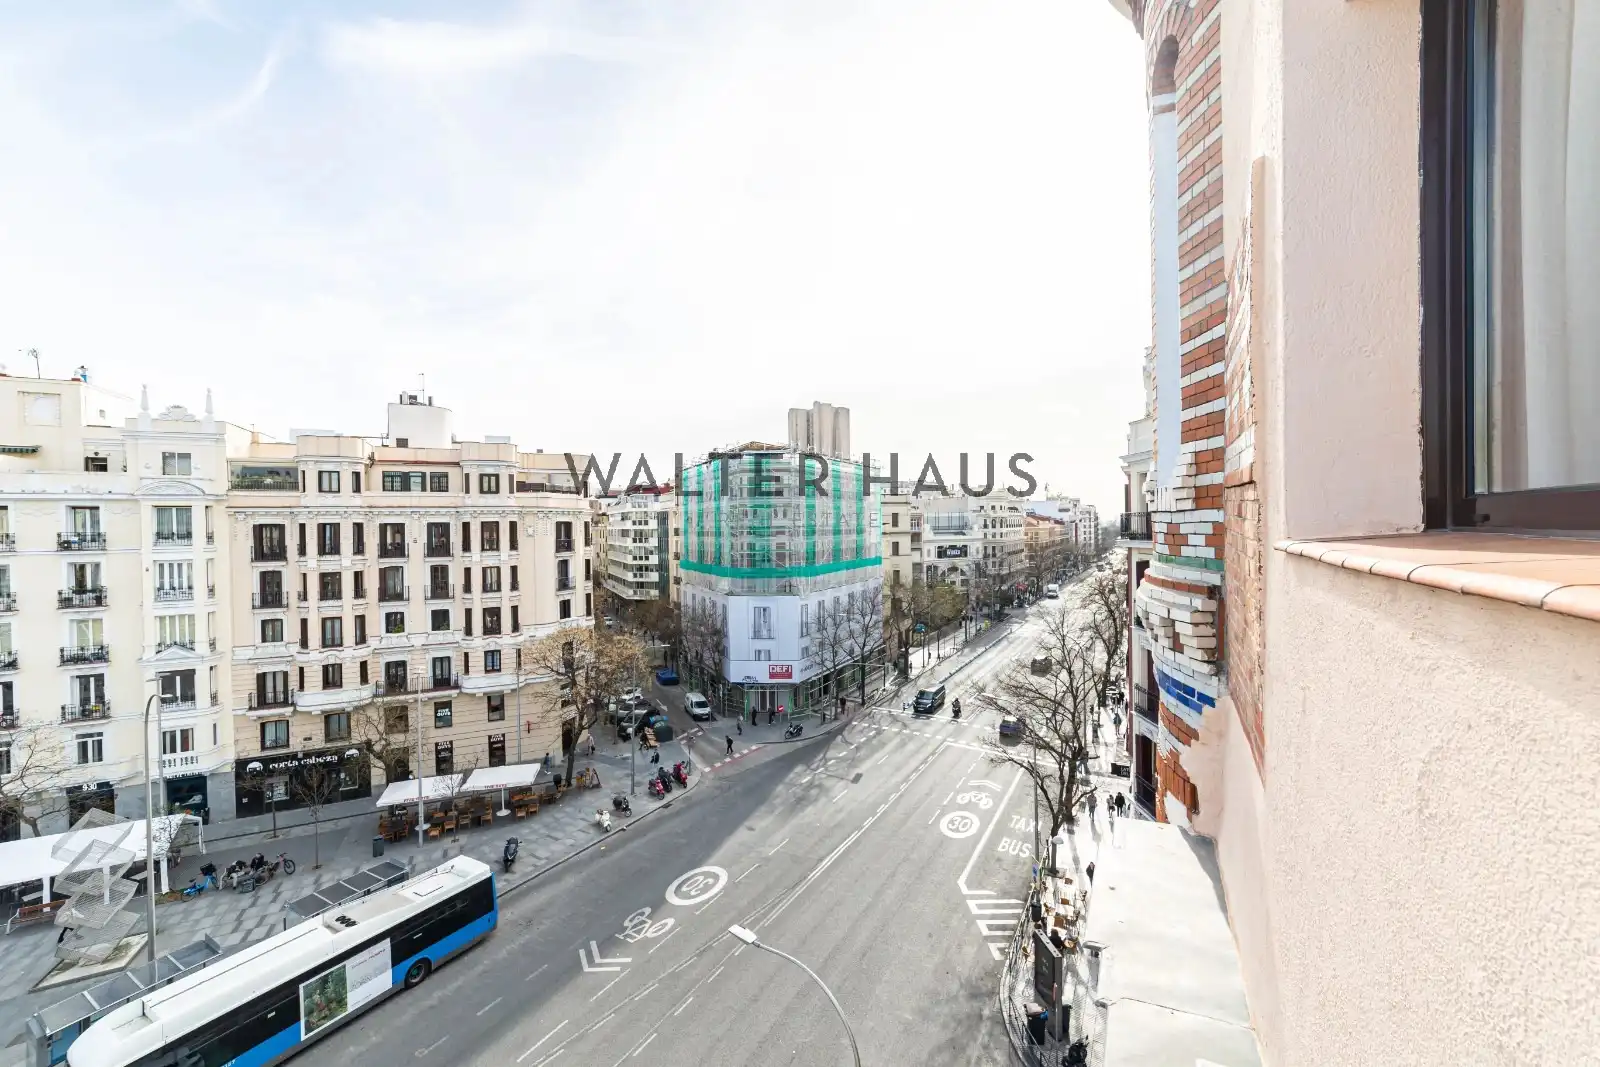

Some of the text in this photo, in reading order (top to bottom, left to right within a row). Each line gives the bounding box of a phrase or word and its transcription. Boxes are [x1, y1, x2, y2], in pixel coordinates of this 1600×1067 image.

[769, 665, 792, 673] DEFI
[948, 816, 972, 832] 30
[998, 836, 1032, 858] BUS
